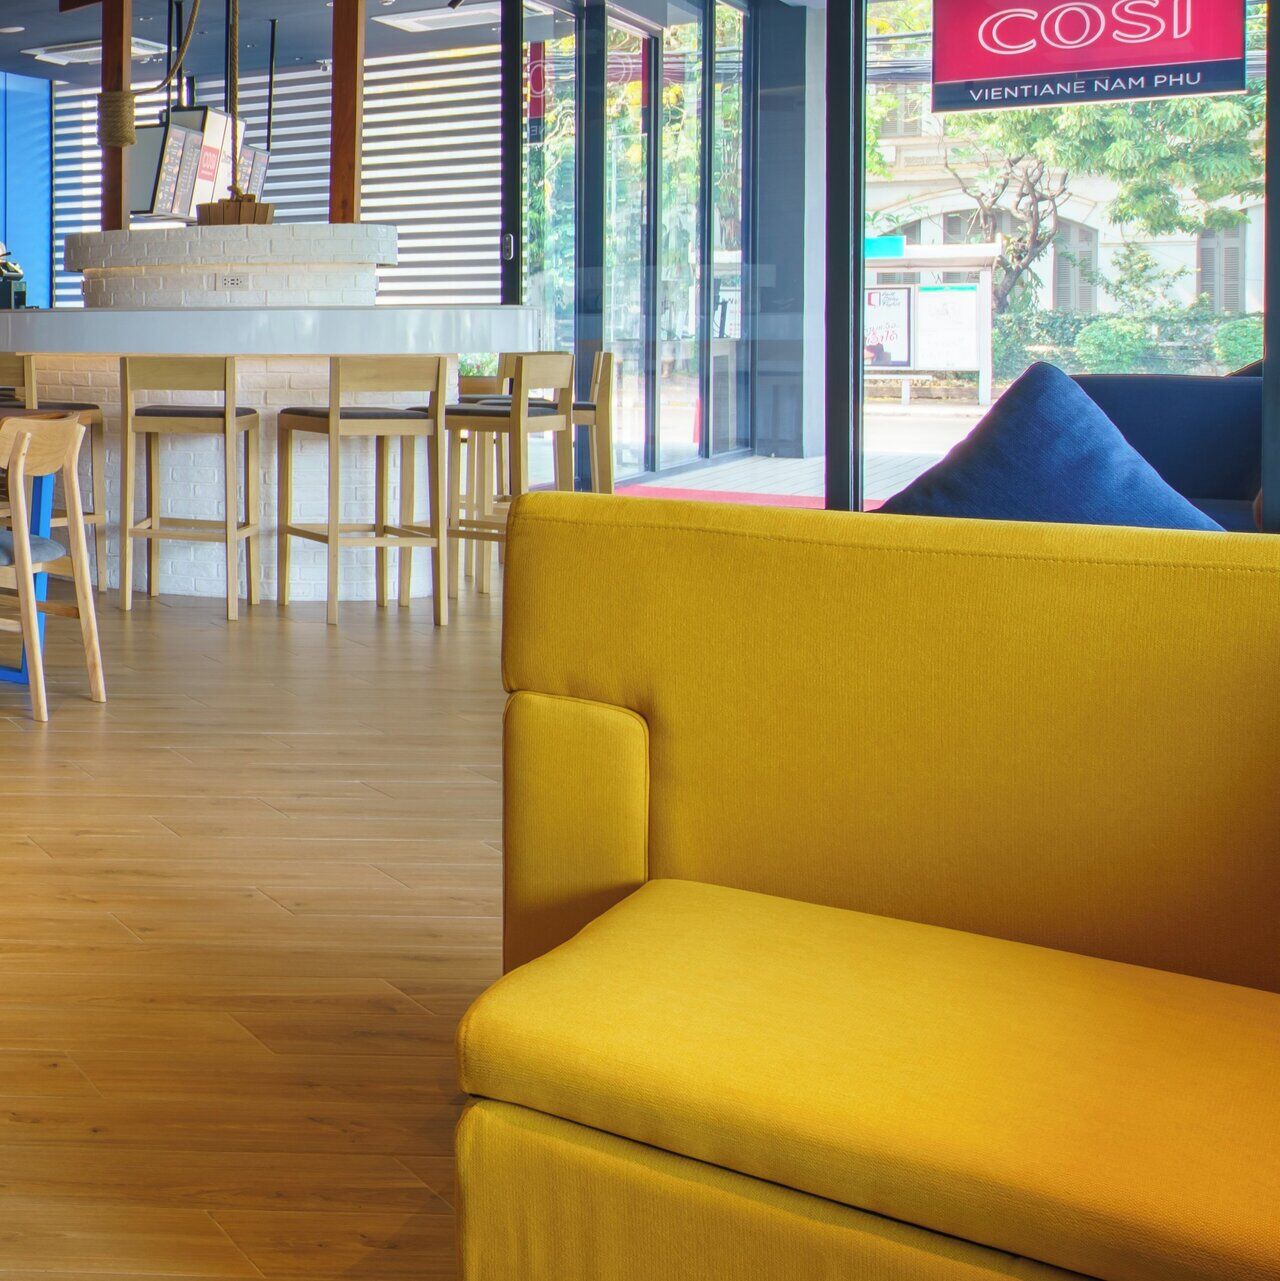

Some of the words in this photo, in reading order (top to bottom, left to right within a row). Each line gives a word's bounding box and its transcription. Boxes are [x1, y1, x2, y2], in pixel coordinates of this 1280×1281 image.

[969, 81, 1086, 102] VIENTIANE
[1094, 76, 1146, 93] NAM
[1154, 71, 1202, 90] PHU
